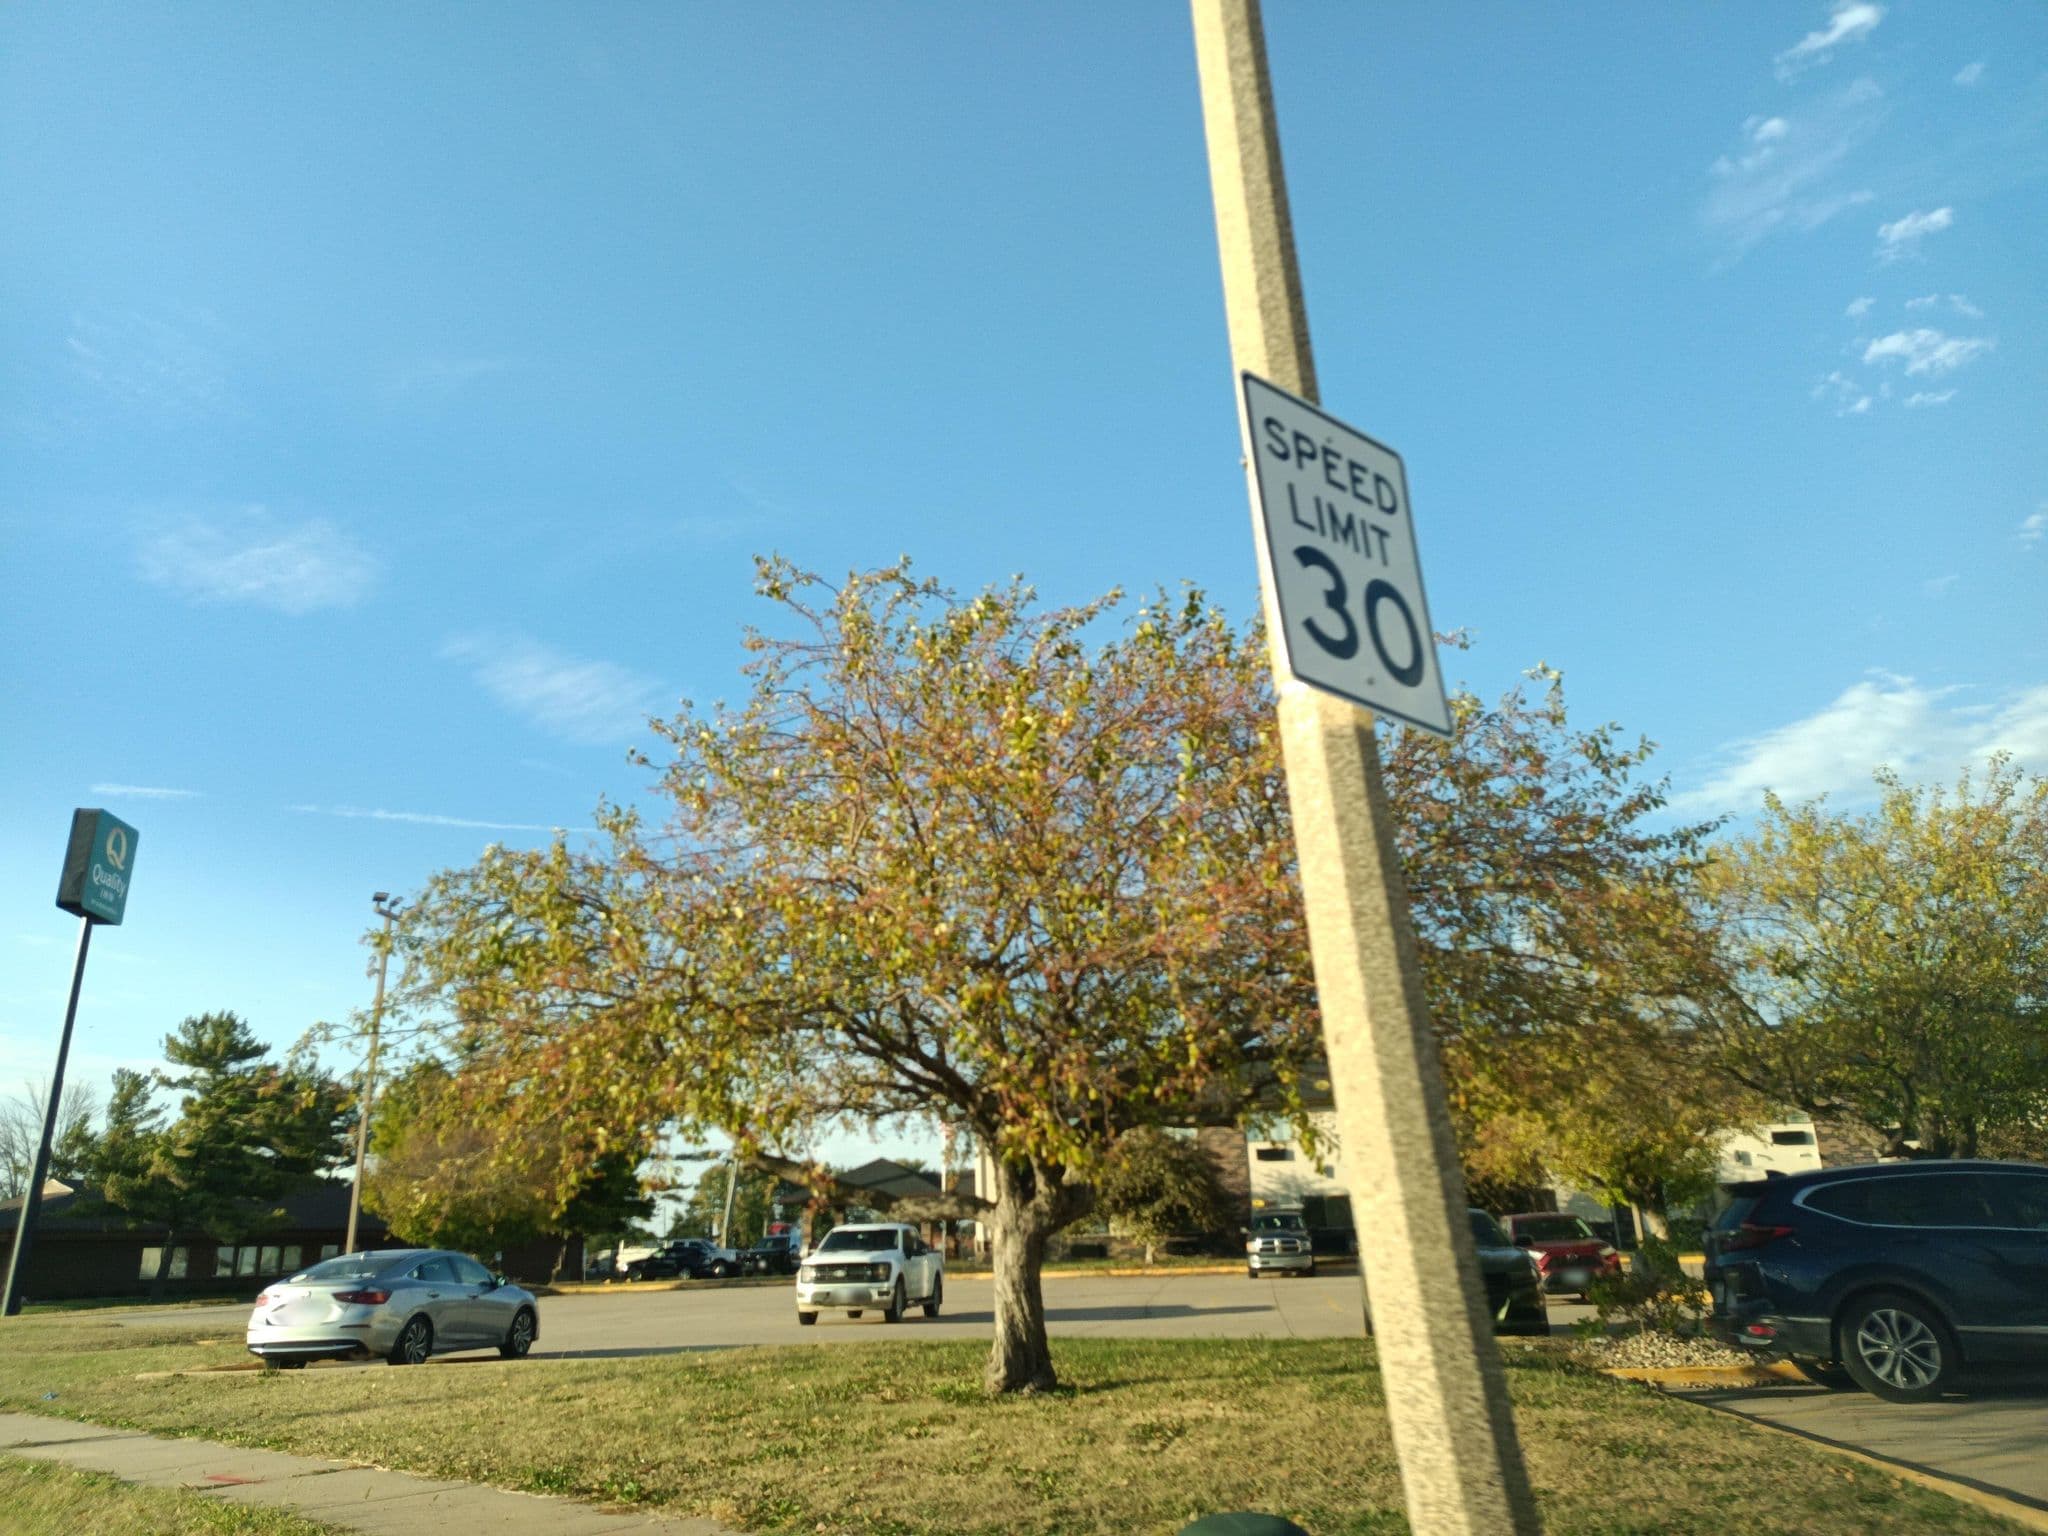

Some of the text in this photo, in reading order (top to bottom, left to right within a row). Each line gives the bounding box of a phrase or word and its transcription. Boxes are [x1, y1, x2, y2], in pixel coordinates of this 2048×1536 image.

[1264, 417, 1398, 515] SPEED
[1287, 481, 1391, 567] LIMIT
[1293, 545, 1424, 688] 30
[92, 863, 125, 897] Quality
[106, 828, 127, 870] Q
